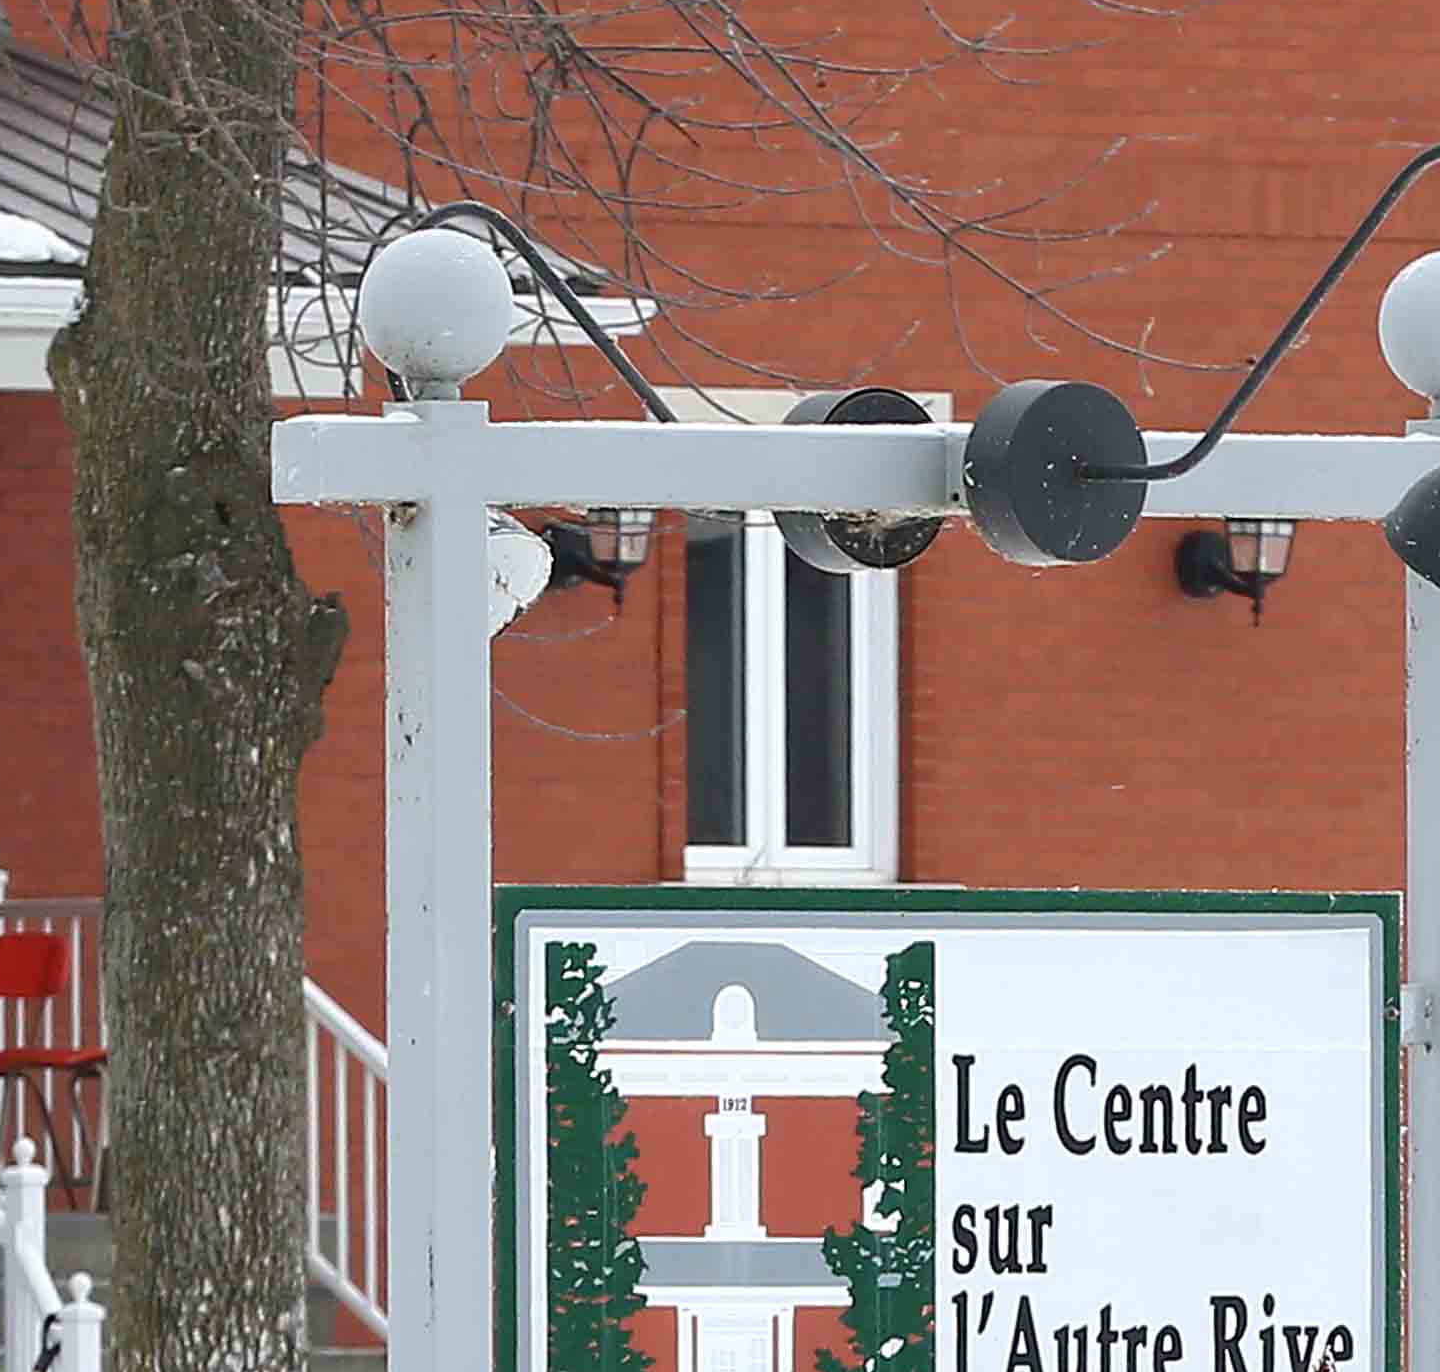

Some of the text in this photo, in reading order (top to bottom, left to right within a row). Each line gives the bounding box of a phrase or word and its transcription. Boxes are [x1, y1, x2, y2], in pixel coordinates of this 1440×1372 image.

[722, 1097, 748, 1111] 1912
[950, 1053, 1268, 1157] Le Centre
[951, 1203, 1054, 1276] sur
